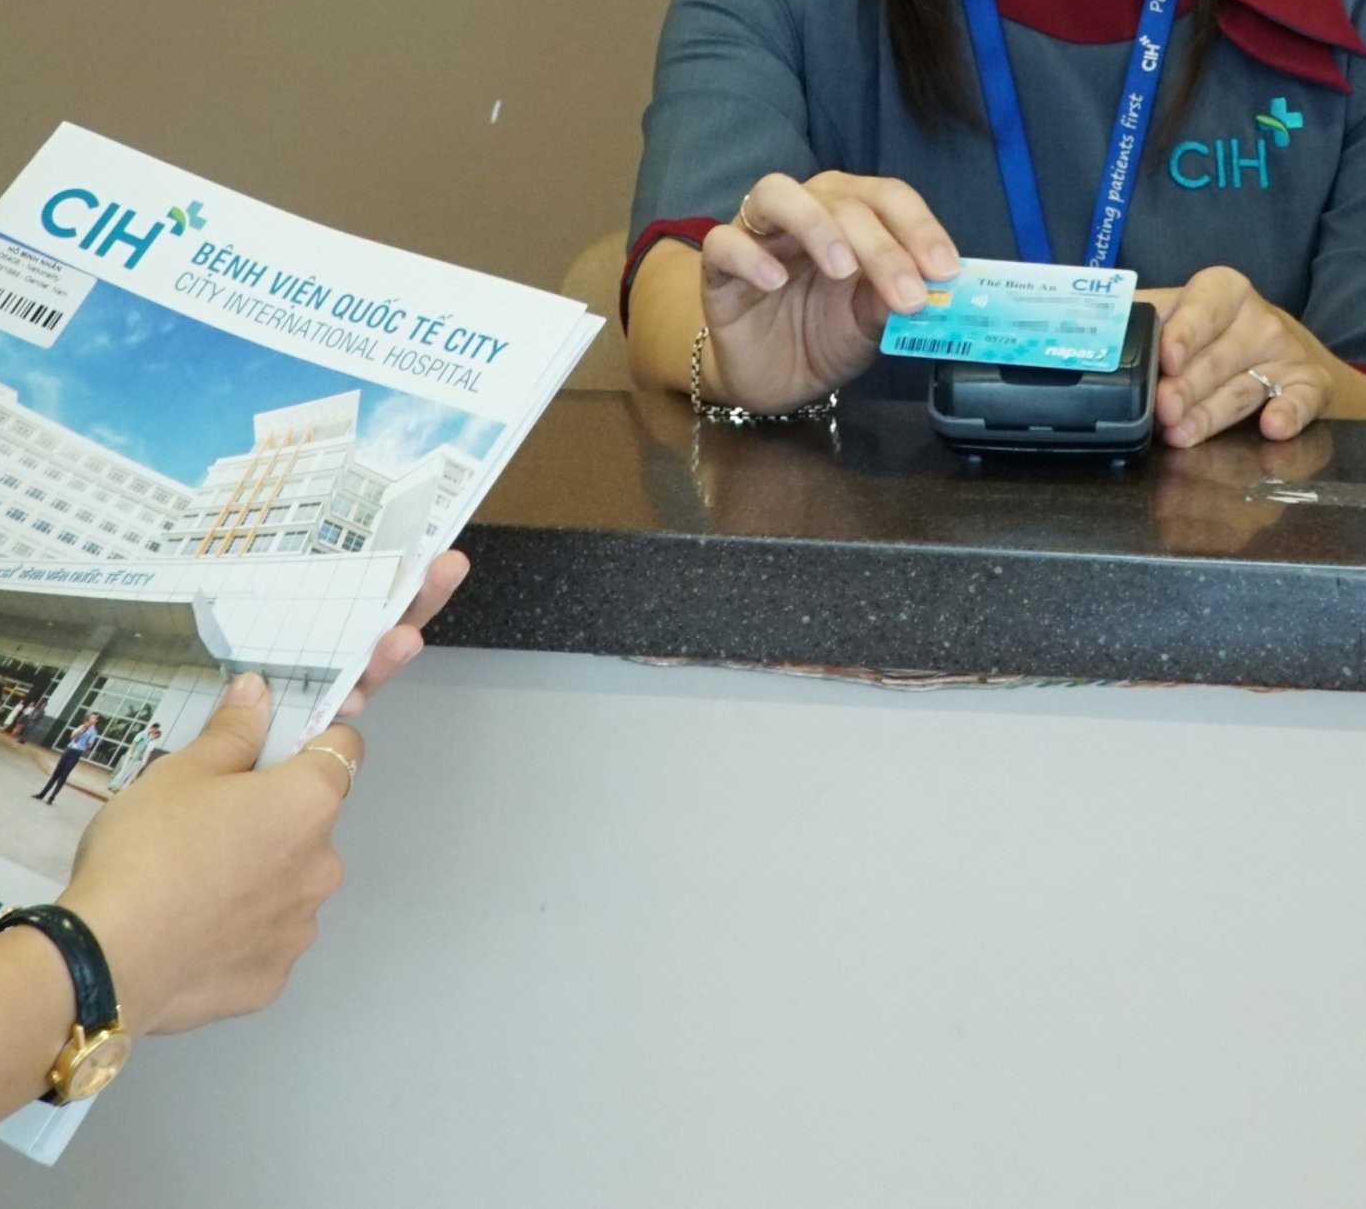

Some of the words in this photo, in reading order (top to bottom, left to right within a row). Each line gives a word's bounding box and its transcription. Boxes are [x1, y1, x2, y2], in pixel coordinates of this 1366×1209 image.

[1141, 43, 1161, 73] CIH
[1120, 92, 1144, 130] first
[1108, 134, 1135, 203] patients
[1168, 138, 1270, 191] CIH
[40, 188, 166, 271] CIH
[1089, 206, 1122, 269] Putting
[191, 240, 267, 289] BỆNH
[269, 271, 334, 315] VIỆN
[331, 292, 407, 336] QUỐC
[413, 311, 454, 346] TẾ
[444, 327, 511, 366] CITY
[1072, 277, 1112, 294] CIH
[173, 271, 227, 306] CITY
[223, 292, 377, 362] INTERNATIONAL
[382, 345, 486, 395] HOSPITAL
[1044, 346, 1095, 361] napas
